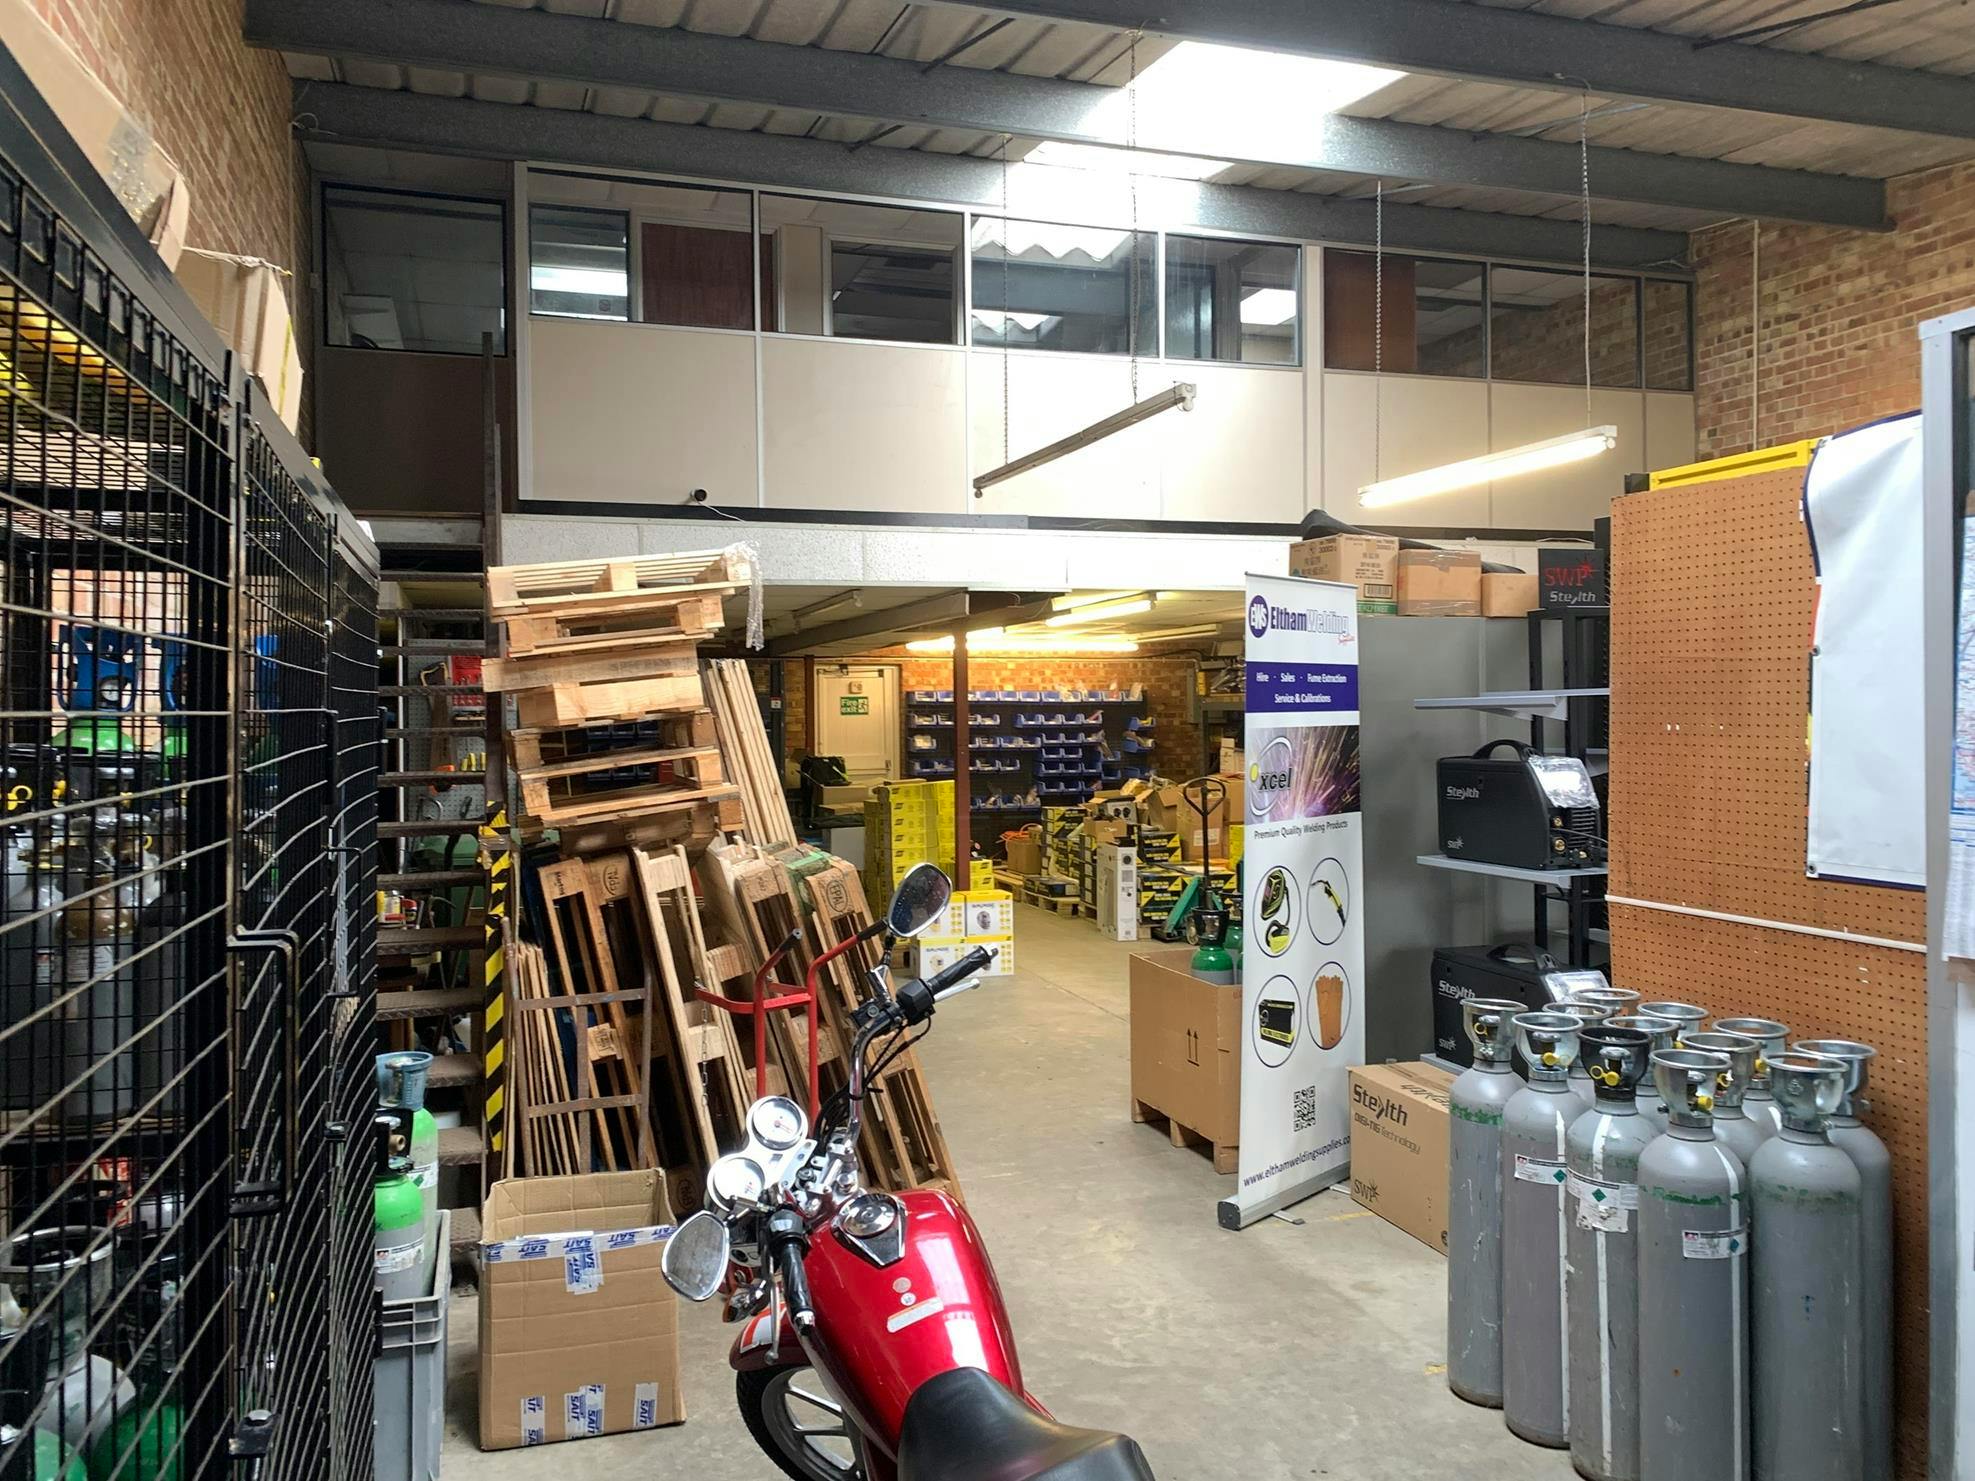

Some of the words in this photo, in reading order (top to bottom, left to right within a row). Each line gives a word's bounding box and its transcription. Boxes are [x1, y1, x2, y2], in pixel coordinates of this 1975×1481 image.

[1544, 566, 1589, 587] SWP
[1256, 672, 1269, 682] Hire
[1280, 672, 1296, 682] Sales
[1307, 673, 1322, 683] Fume
[1322, 673, 1348, 683] Extraction
[840, 699, 858, 707] Fire
[1274, 693, 1294, 704] Service
[1301, 693, 1332, 703] Calibrations
[1254, 828, 1280, 840] Premium
[1282, 826, 1302, 838] Quality
[1304, 823, 1325, 834] Welding
[1326, 820, 1348, 832] Products
[830, 883, 845, 908] EPAL
[1381, 1126, 1421, 1154] Technology
[1354, 1179, 1379, 1203] SWP
[570, 1396, 580, 1421] SAIT
[640, 1399, 648, 1426] SAIT
[587, 1409, 596, 1434] SAIT
